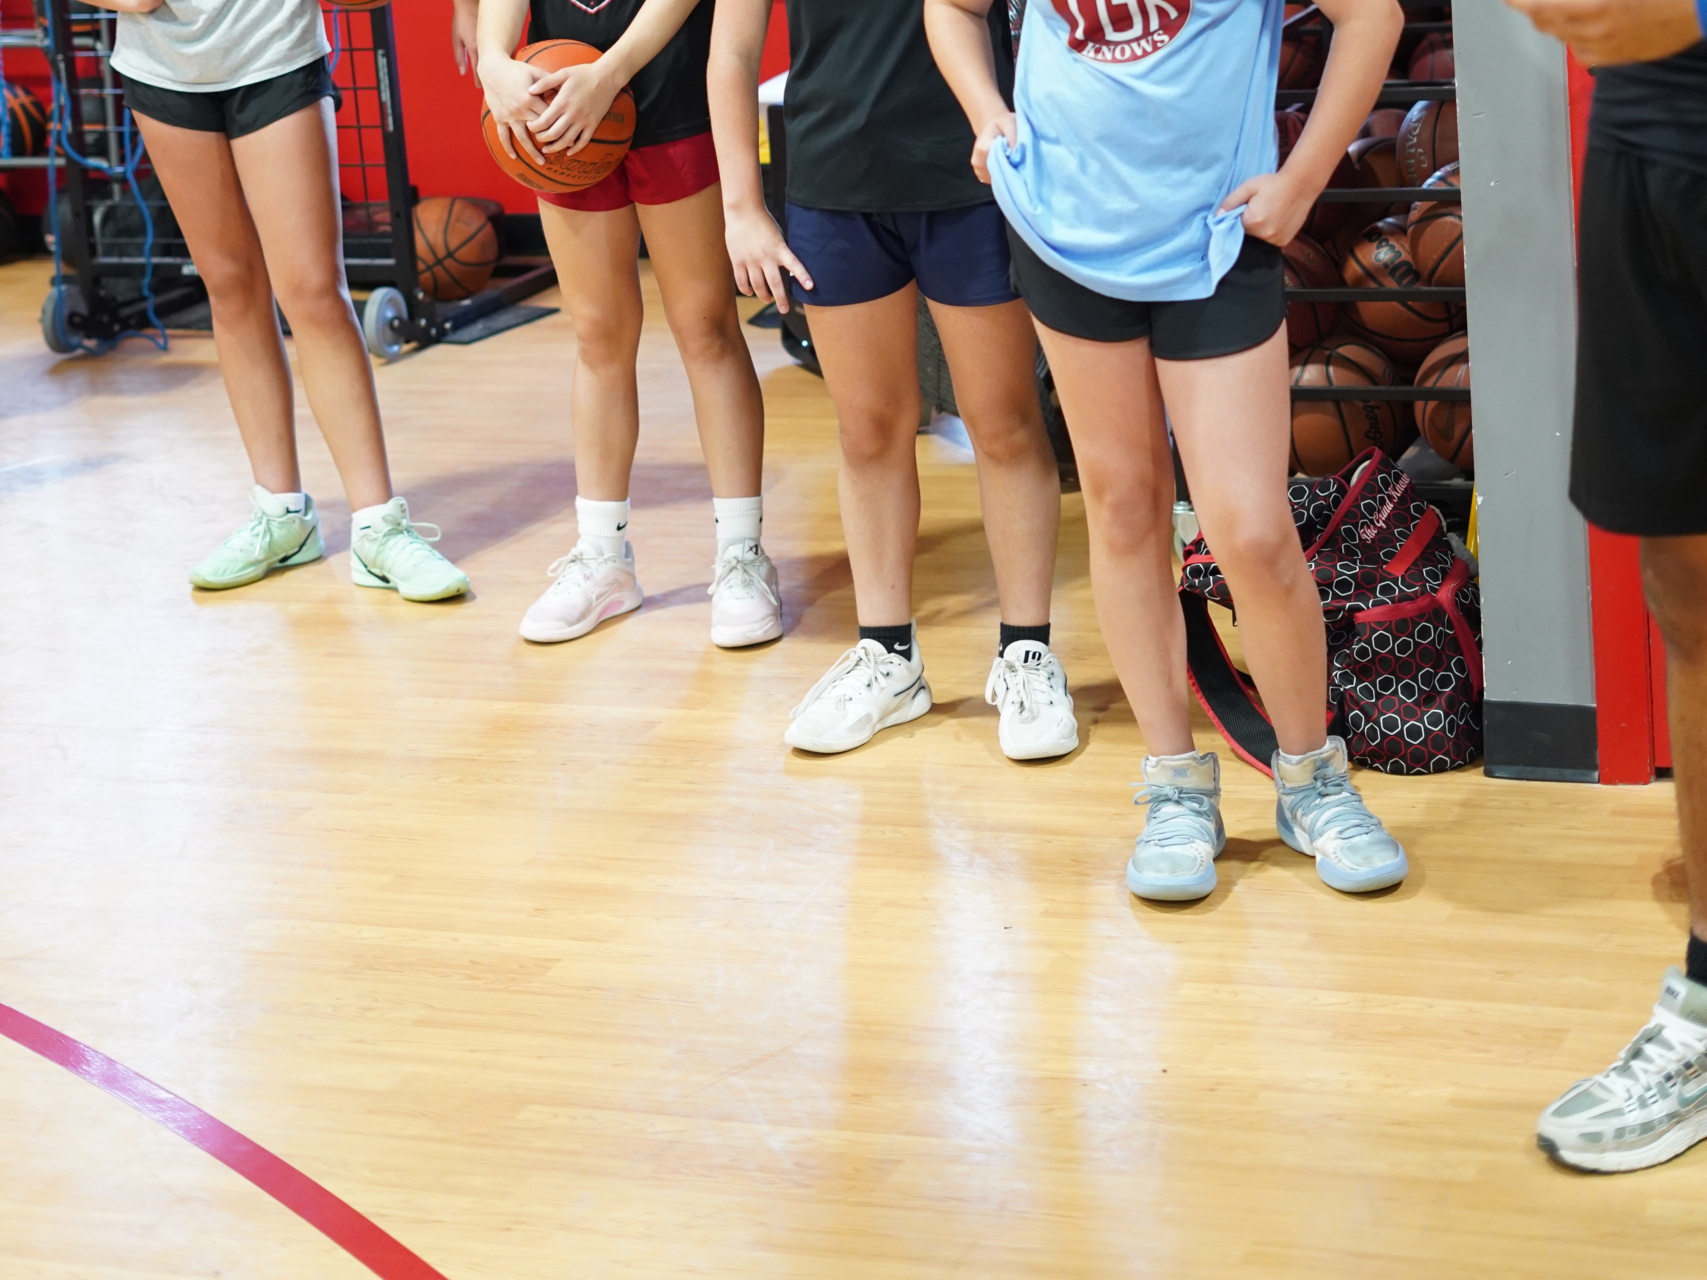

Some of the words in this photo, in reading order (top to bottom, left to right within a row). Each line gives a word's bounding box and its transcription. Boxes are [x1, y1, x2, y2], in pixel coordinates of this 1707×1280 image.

[1080, 30, 1170, 61] KNOWS
[1360, 524, 1377, 543] The
[1373, 495, 1394, 529] Grind
[1388, 473, 1410, 502] Know
